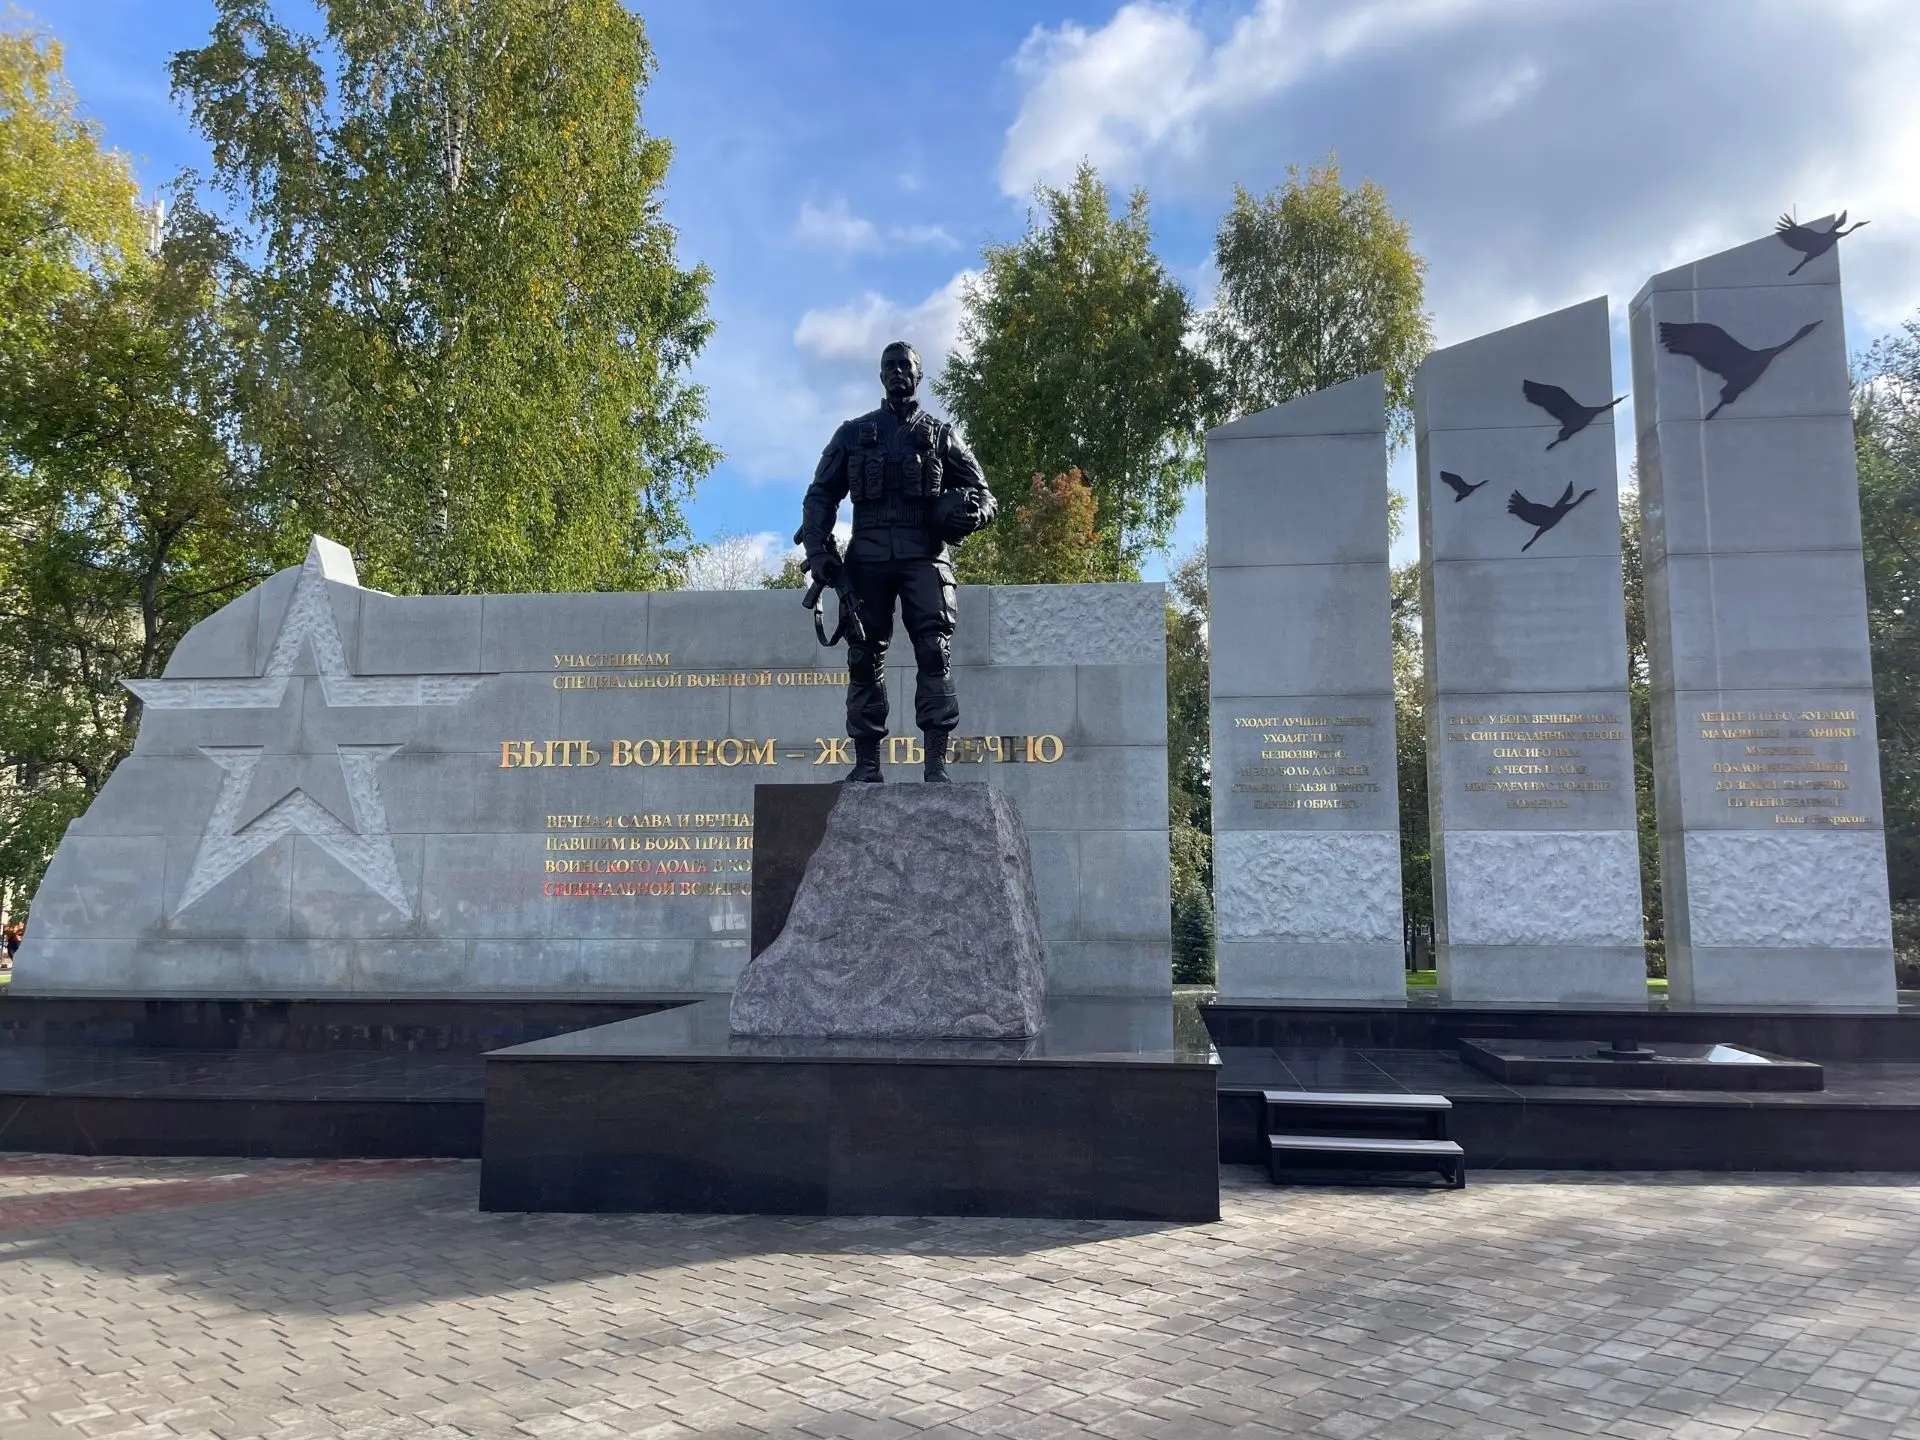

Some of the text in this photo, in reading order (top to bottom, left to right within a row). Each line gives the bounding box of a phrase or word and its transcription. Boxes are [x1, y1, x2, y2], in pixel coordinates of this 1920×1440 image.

[554, 653, 671, 669] УЧАСТНИКАМ
[552, 669, 849, 690] СПЕЦИАЛЬНОЙ ВОЕННОЙ ОПЕРАЦ
[1234, 717, 1279, 728] УХОДЯТ
[1263, 733, 1308, 744] УХОДЯТ
[499, 740, 601, 768] БЫТЬ
[609, 738, 778, 768] ВОИНОМ
[813, 736, 925, 765] ЖТЬ
[546, 813, 754, 828] ВЕЧНАЯ СЛАВА И ВЕЧНА
[546, 837, 625, 851] ПАВШИМ
[629, 837, 640, 850] В
[644, 837, 691, 850] БОЯХ
[695, 836, 731, 850] ПРИ
[544, 859, 651, 873] ВОИНСКОГО
[656, 859, 708, 875] ДОЛГА
[712, 859, 724, 872] В
[543, 881, 752, 896] СПЕЦИАЛЬНОЙ ВОЕННО
